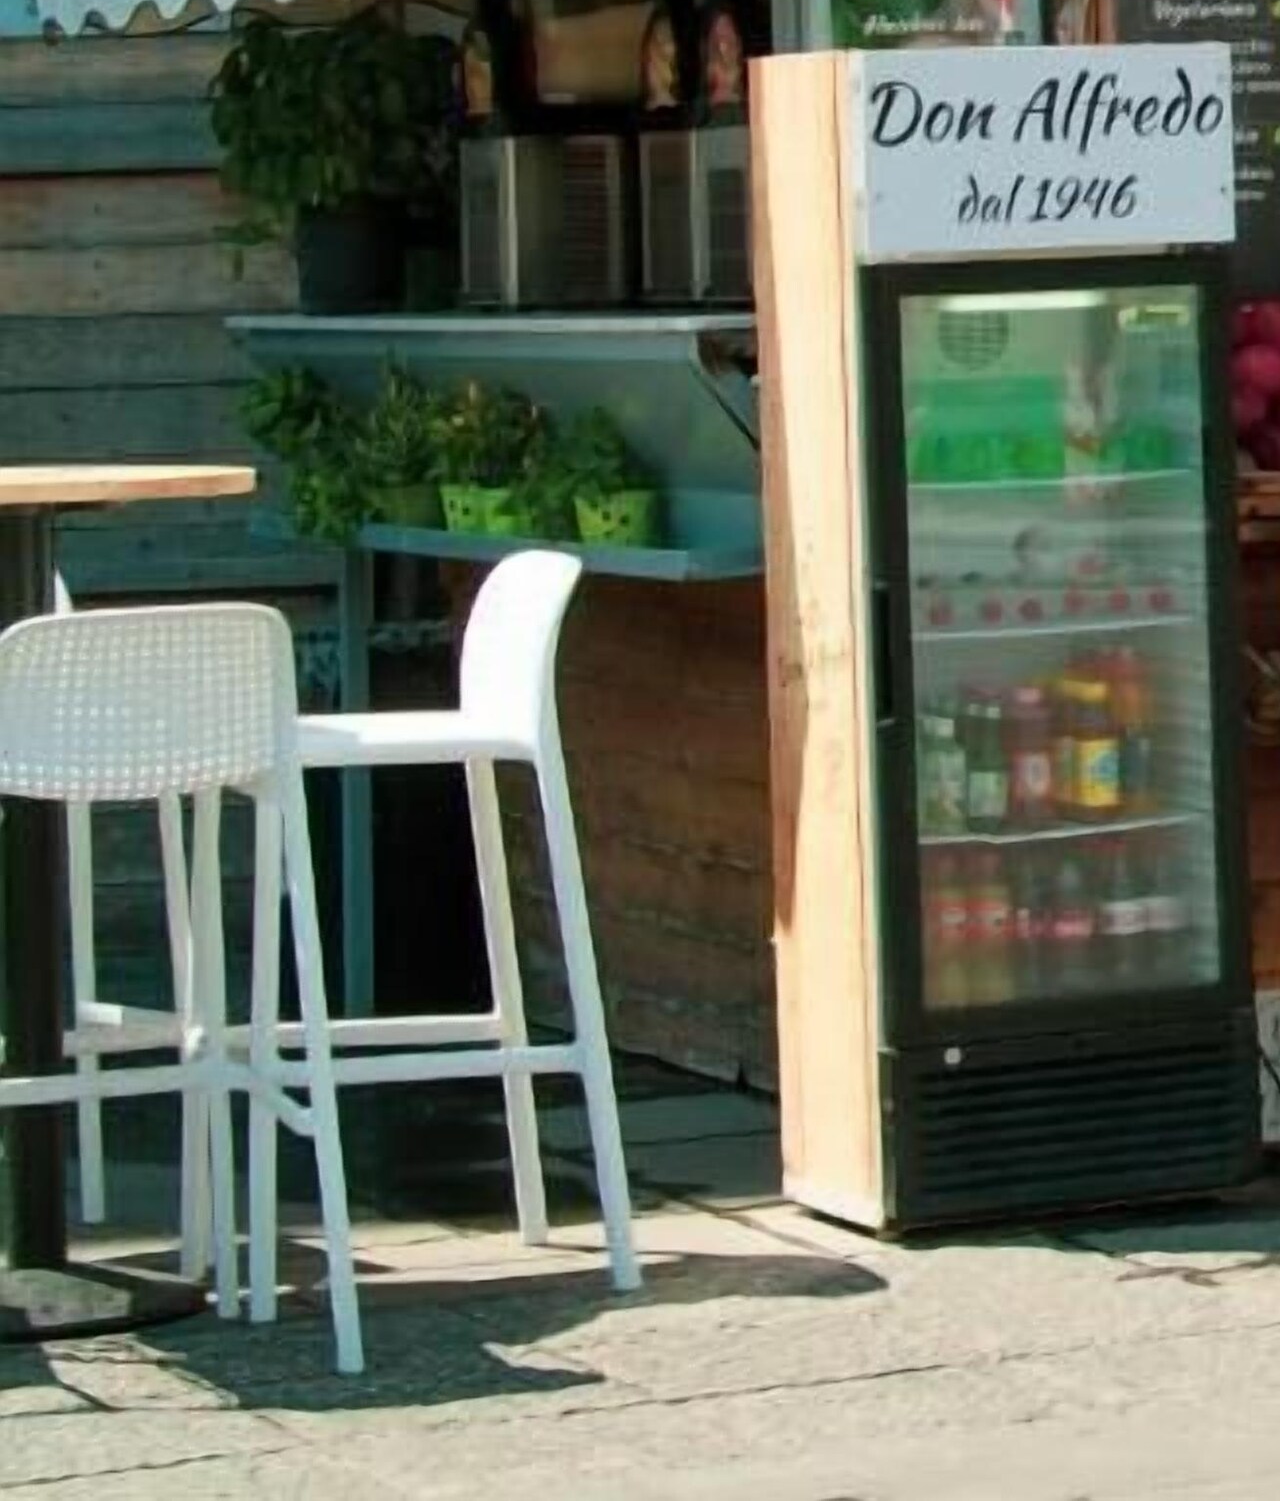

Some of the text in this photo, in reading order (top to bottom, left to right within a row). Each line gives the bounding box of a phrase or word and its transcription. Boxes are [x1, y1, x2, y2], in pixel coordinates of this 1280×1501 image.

[870, 80, 997, 147] Don
[1013, 67, 1225, 156] Alfredo
[957, 173, 1138, 228] dal 1946
